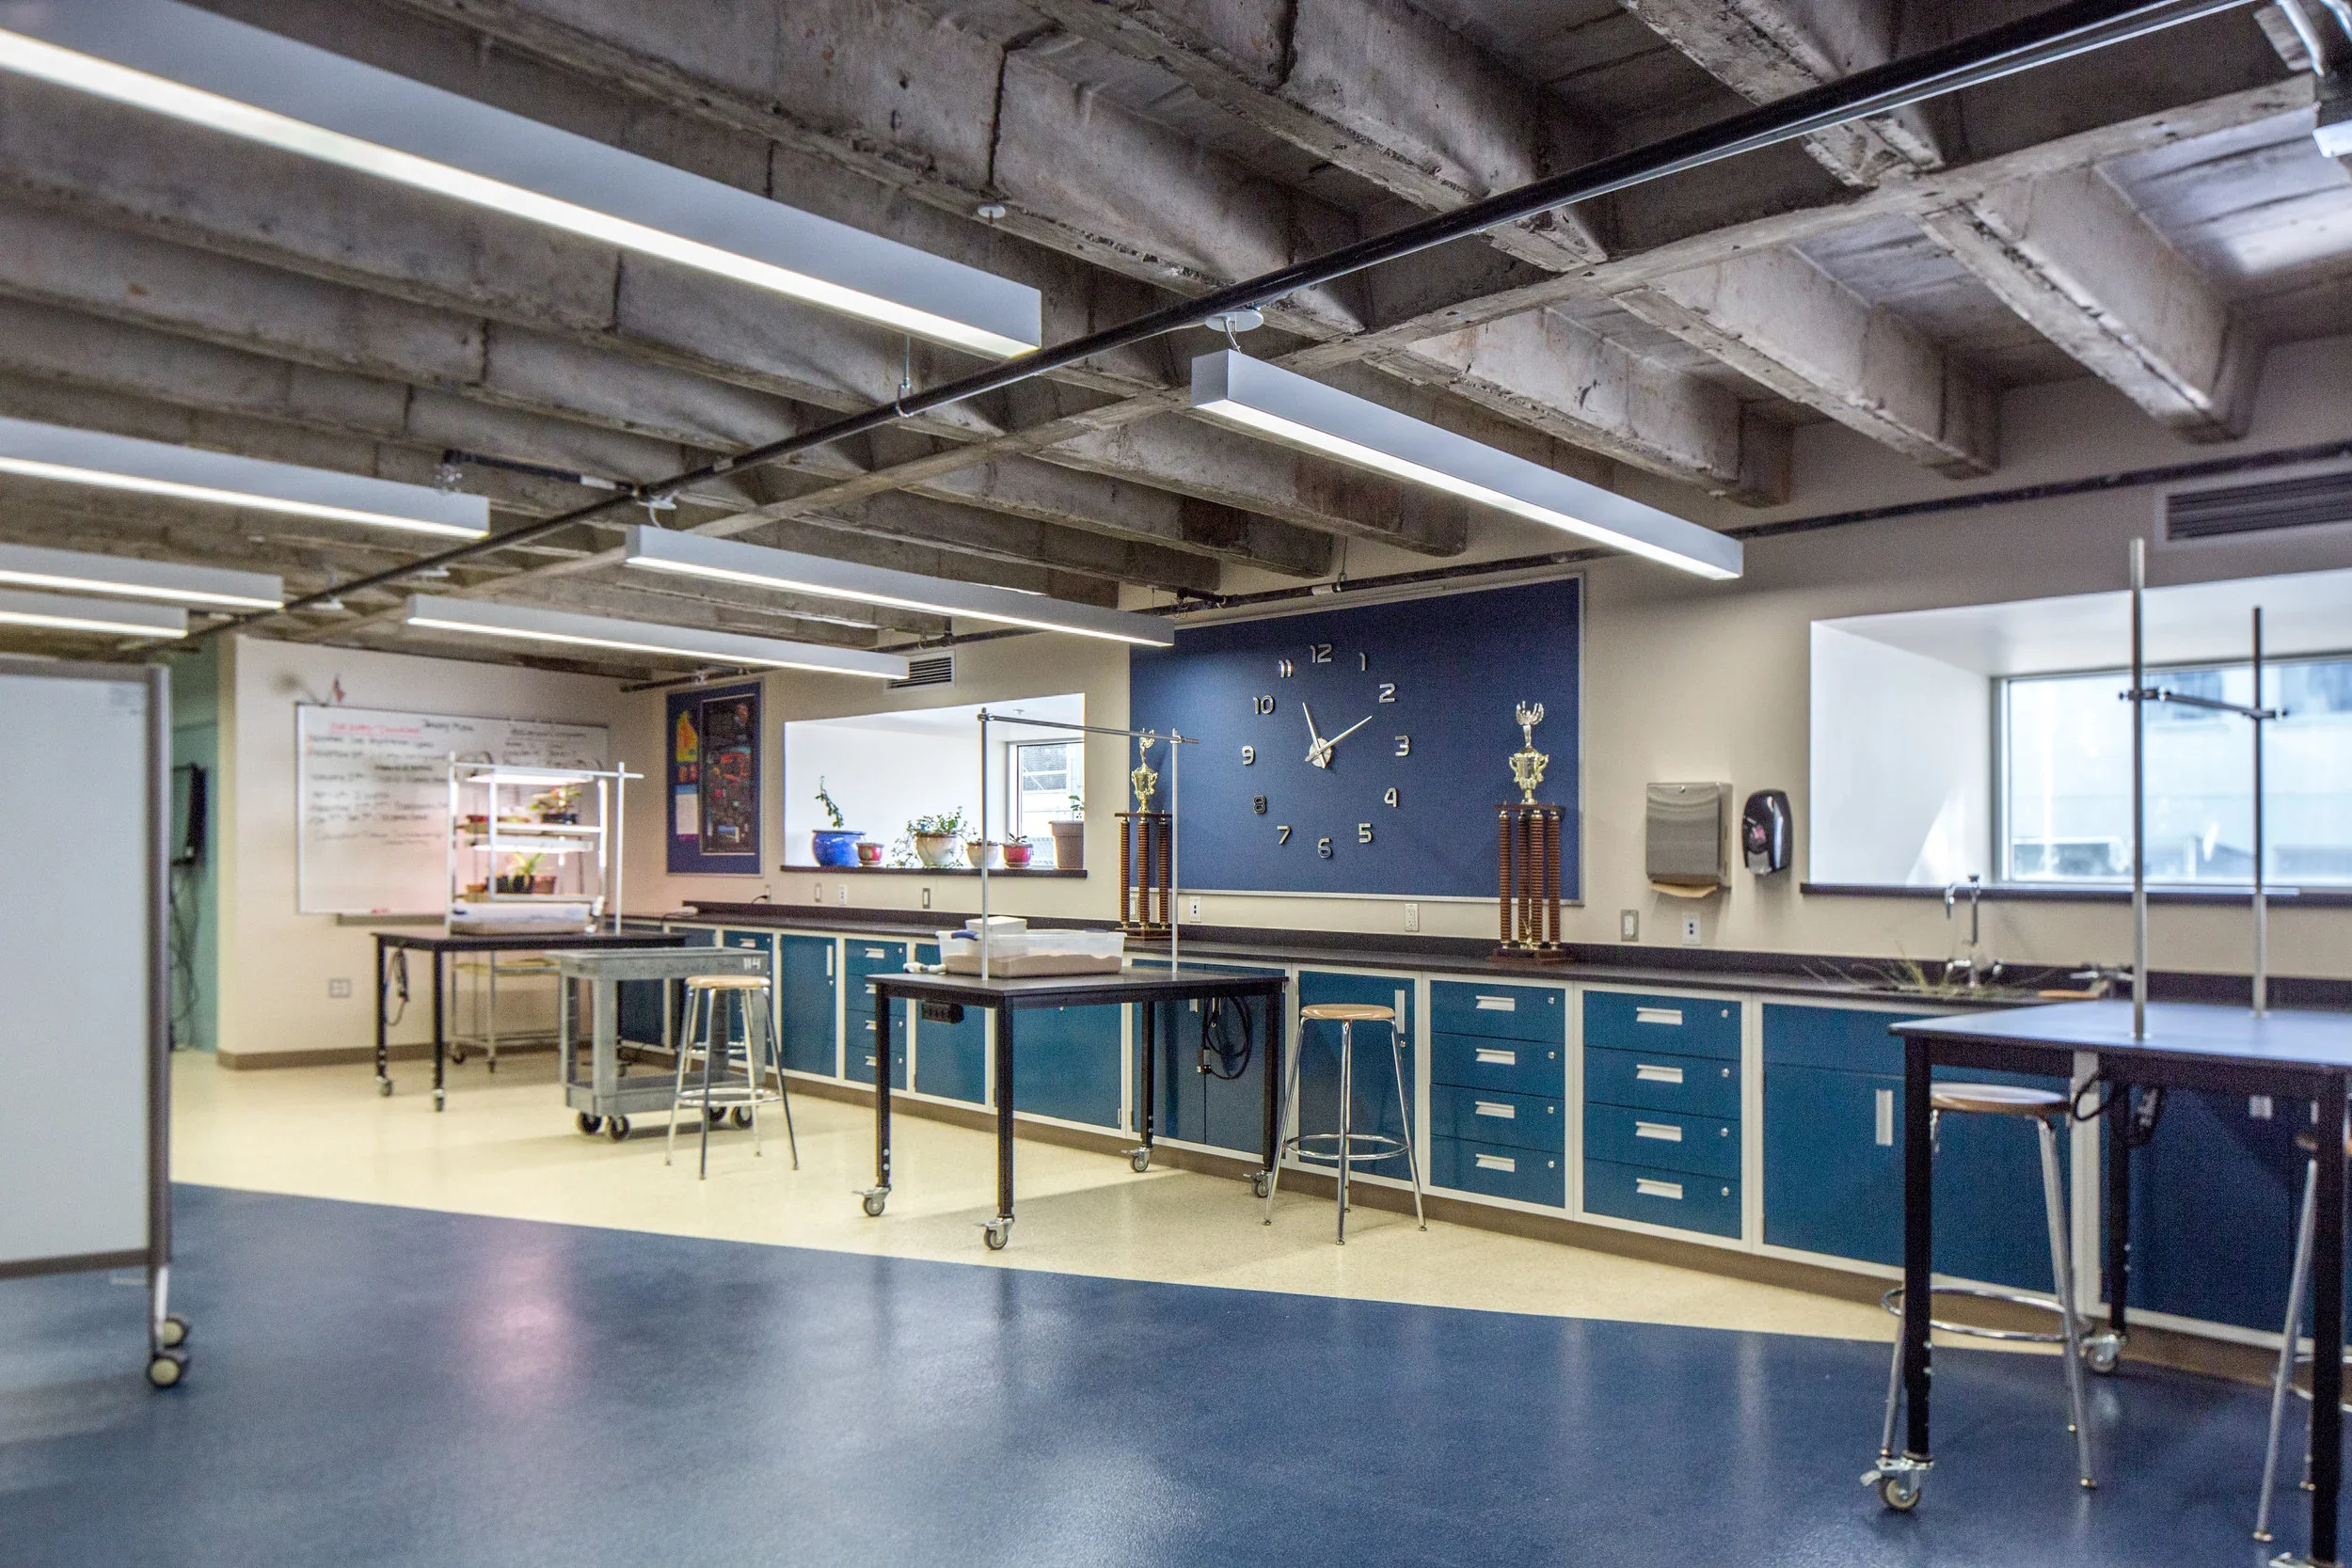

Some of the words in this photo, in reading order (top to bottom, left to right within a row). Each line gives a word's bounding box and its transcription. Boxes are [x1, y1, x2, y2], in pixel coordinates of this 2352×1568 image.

[1311, 643, 1332, 663] 12
[1359, 652, 1366, 671] 1
[1279, 659, 1292, 677] 11
[1379, 683, 1396, 704] 2
[1253, 695, 1274, 714] 10
[1241, 745, 1254, 765] 9
[1395, 736, 1410, 756] 3
[1253, 795, 1266, 814] 8
[1384, 787, 1398, 808] 4
[1277, 825, 1291, 844] 7
[1359, 823, 1373, 843] 5
[1318, 838, 1332, 859] 6
